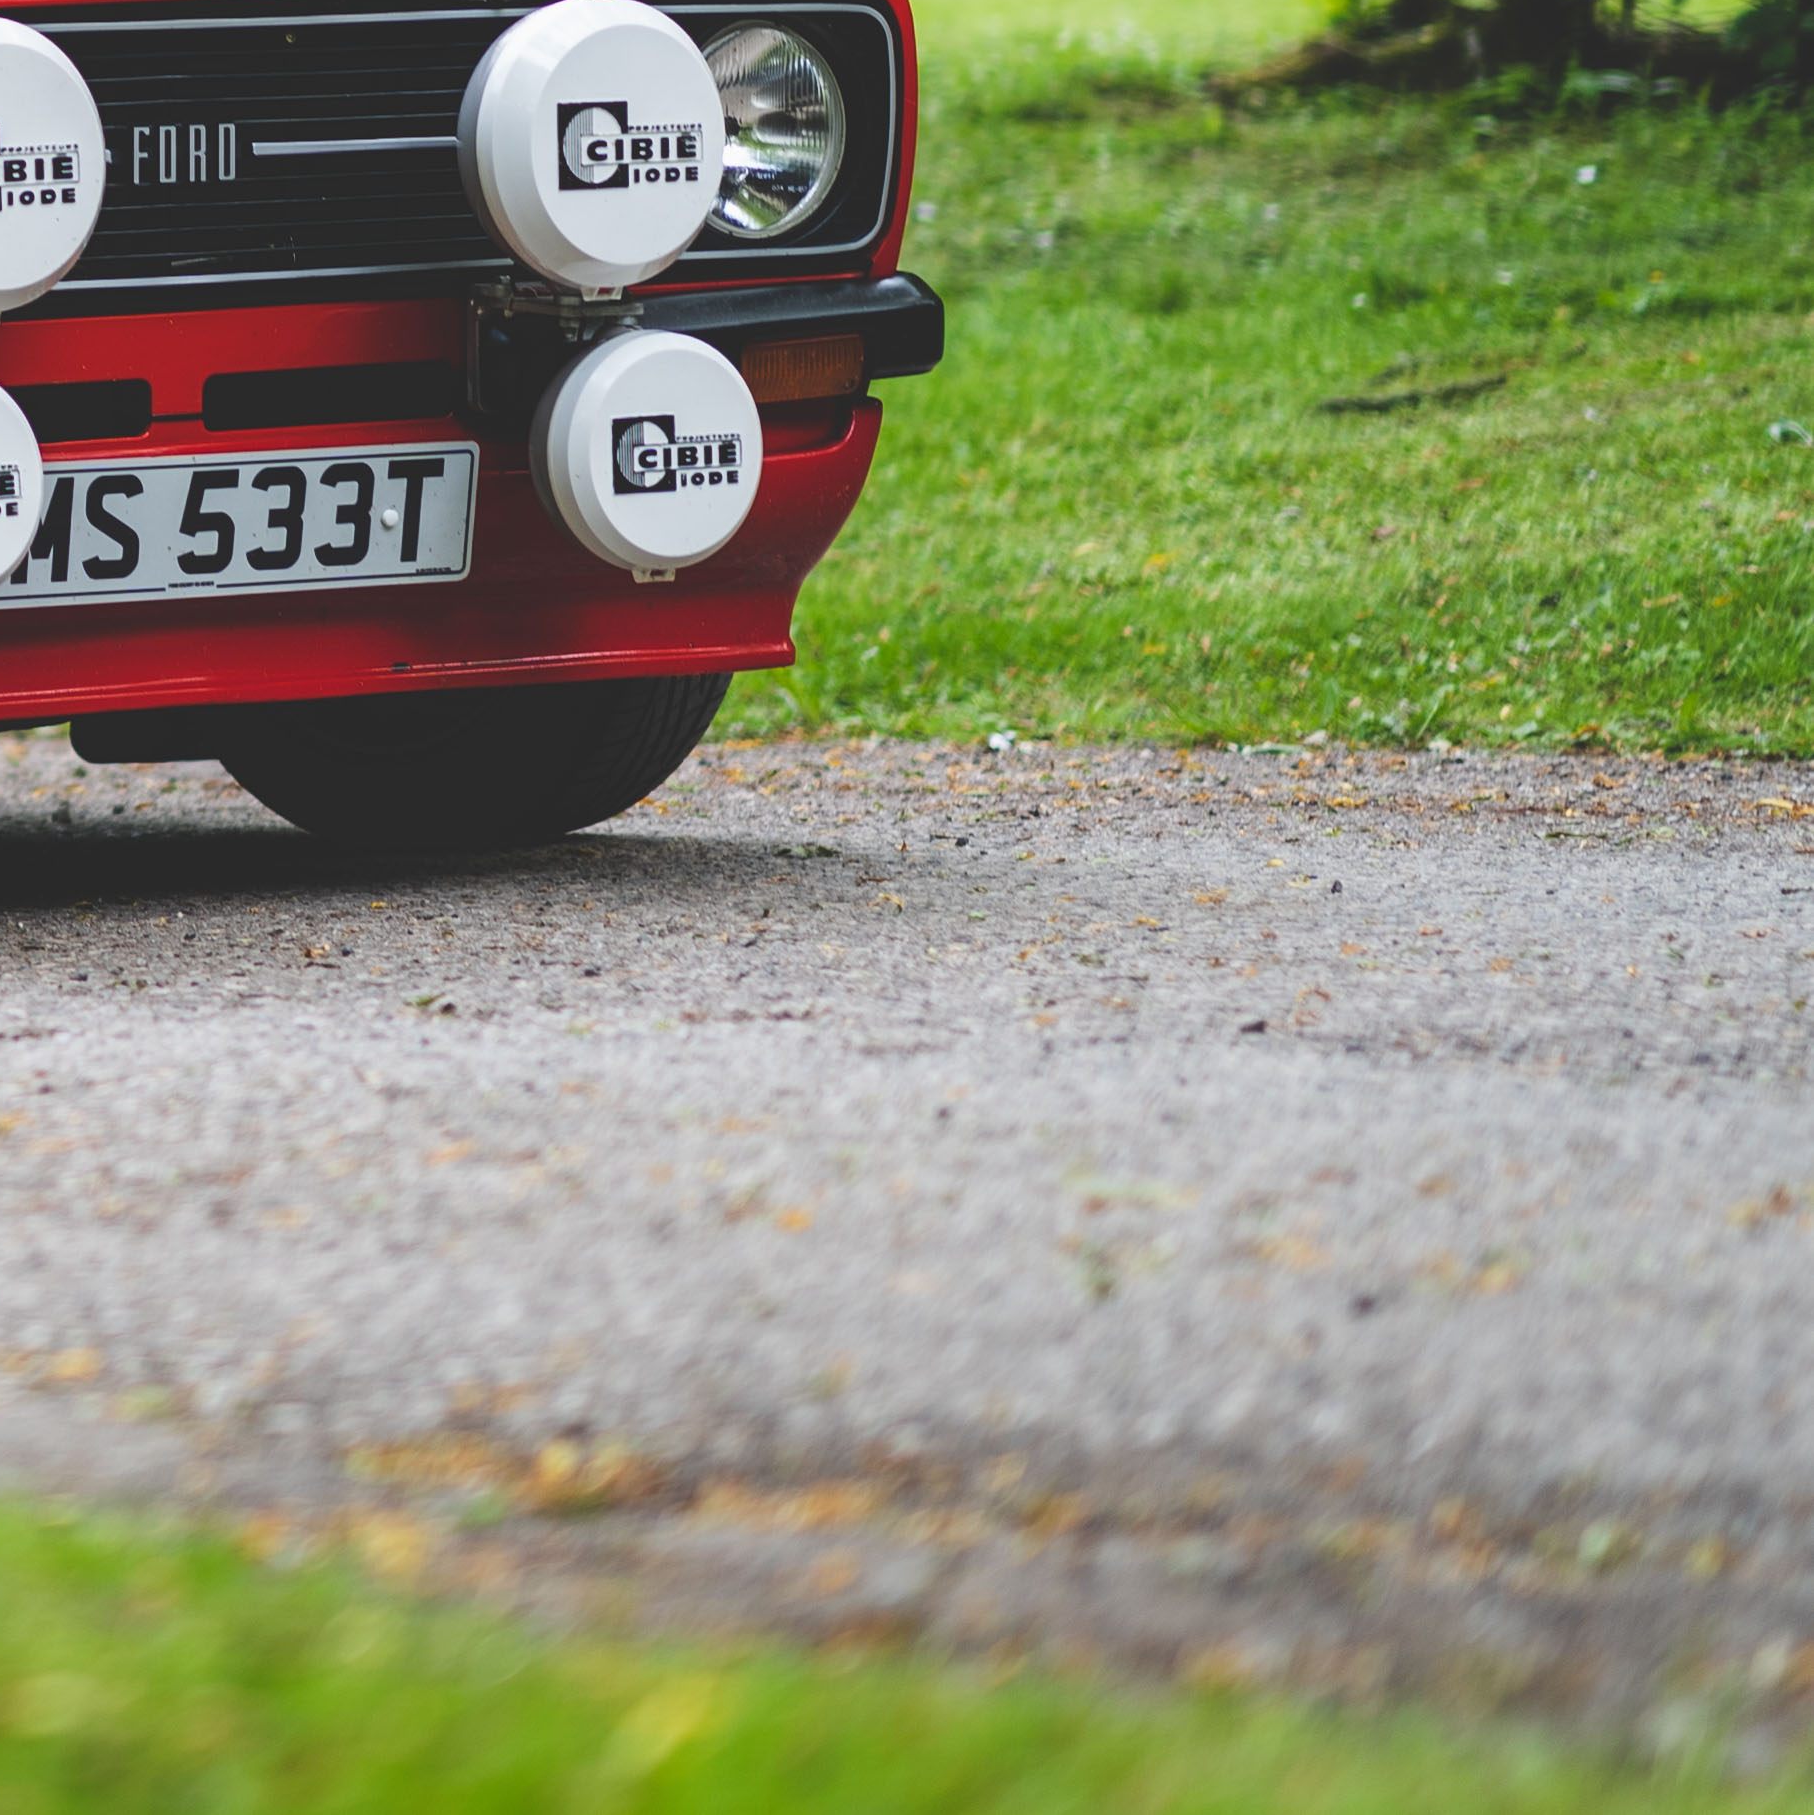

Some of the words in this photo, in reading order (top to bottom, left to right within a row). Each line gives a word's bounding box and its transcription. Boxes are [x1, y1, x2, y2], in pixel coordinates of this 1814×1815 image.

[133, 123, 236, 185] FORD
[633, 166, 699, 184] IODE
[7, 188, 76, 206] IODE
[680, 470, 739, 487] IODE
[176, 457, 446, 575] 533T
